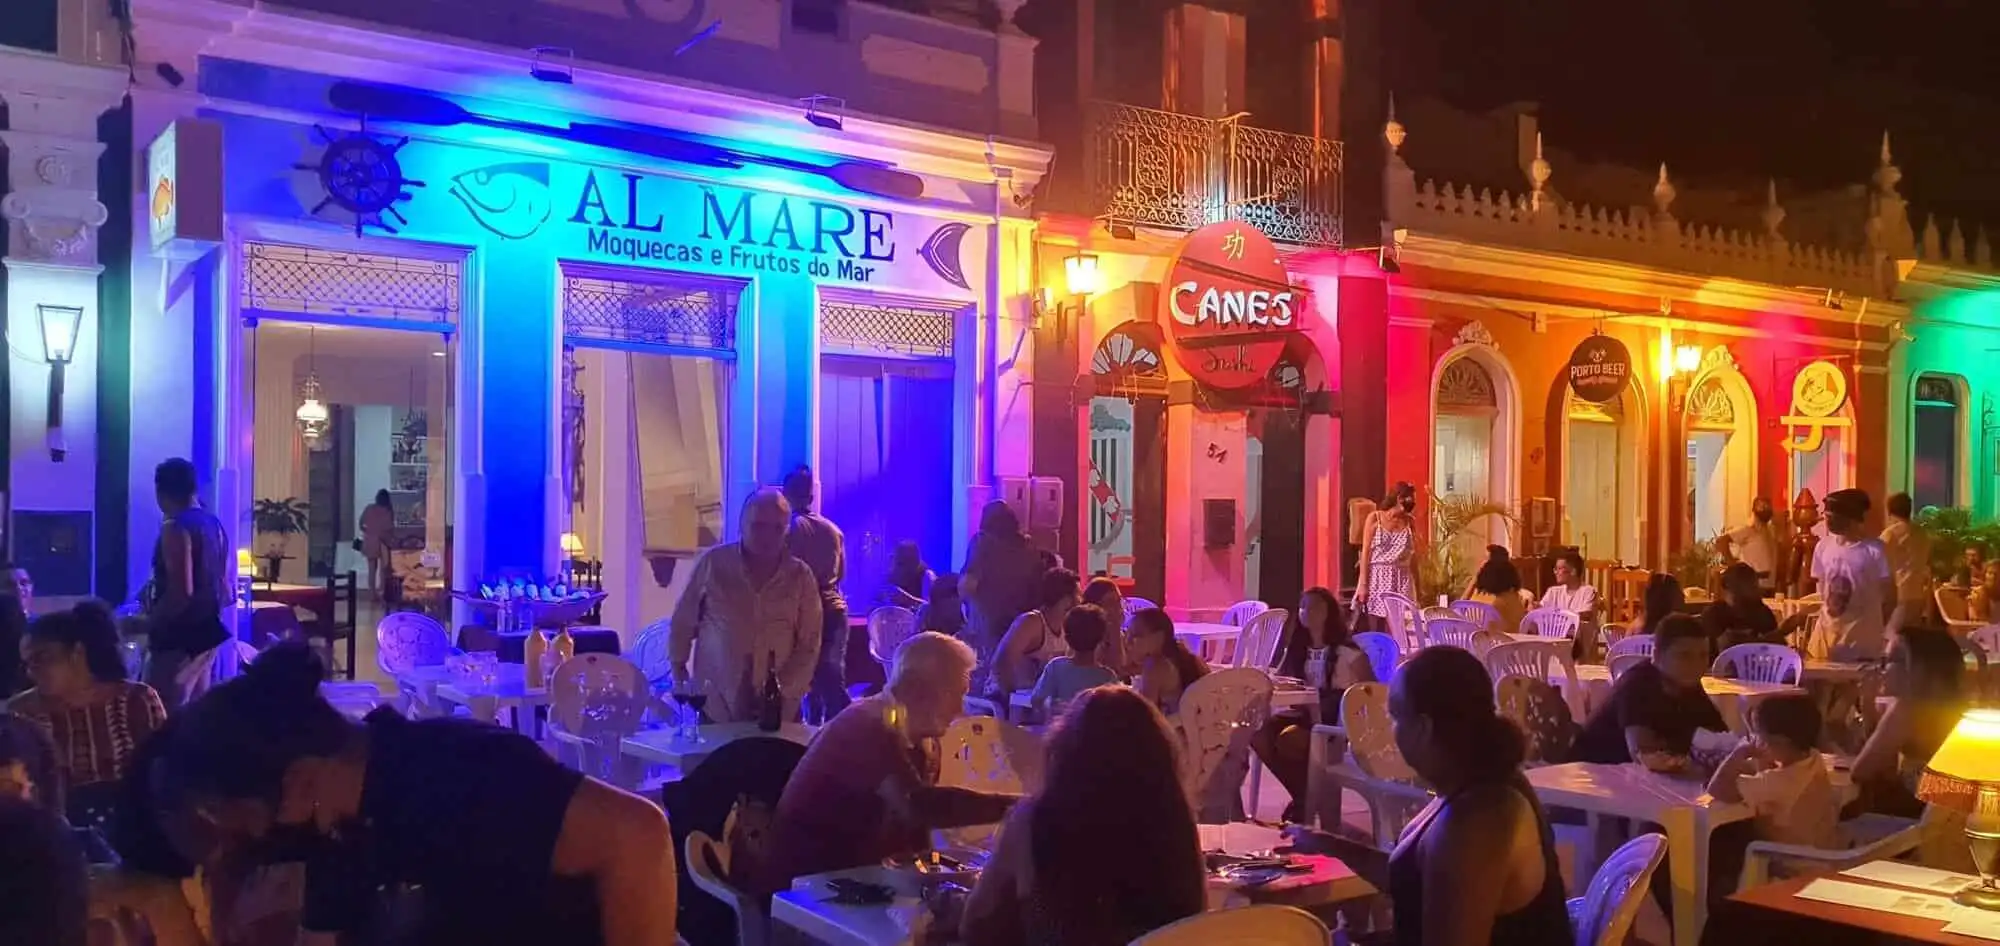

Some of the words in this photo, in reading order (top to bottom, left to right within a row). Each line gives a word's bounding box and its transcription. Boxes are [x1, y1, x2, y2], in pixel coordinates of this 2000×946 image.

[567, 168, 663, 232] AL
[697, 184, 896, 262] MARE
[587, 228, 701, 262] Moquecas
[710, 248, 722, 264] e
[730, 245, 800, 274] Frutos
[808, 259, 830, 277] do
[837, 261, 875, 282] Mar
[1221, 228, 1246, 261] 功
[1170, 281, 1292, 326] CANES
[1571, 364, 1601, 379] PORTO
[1602, 362, 1626, 377] BEER
